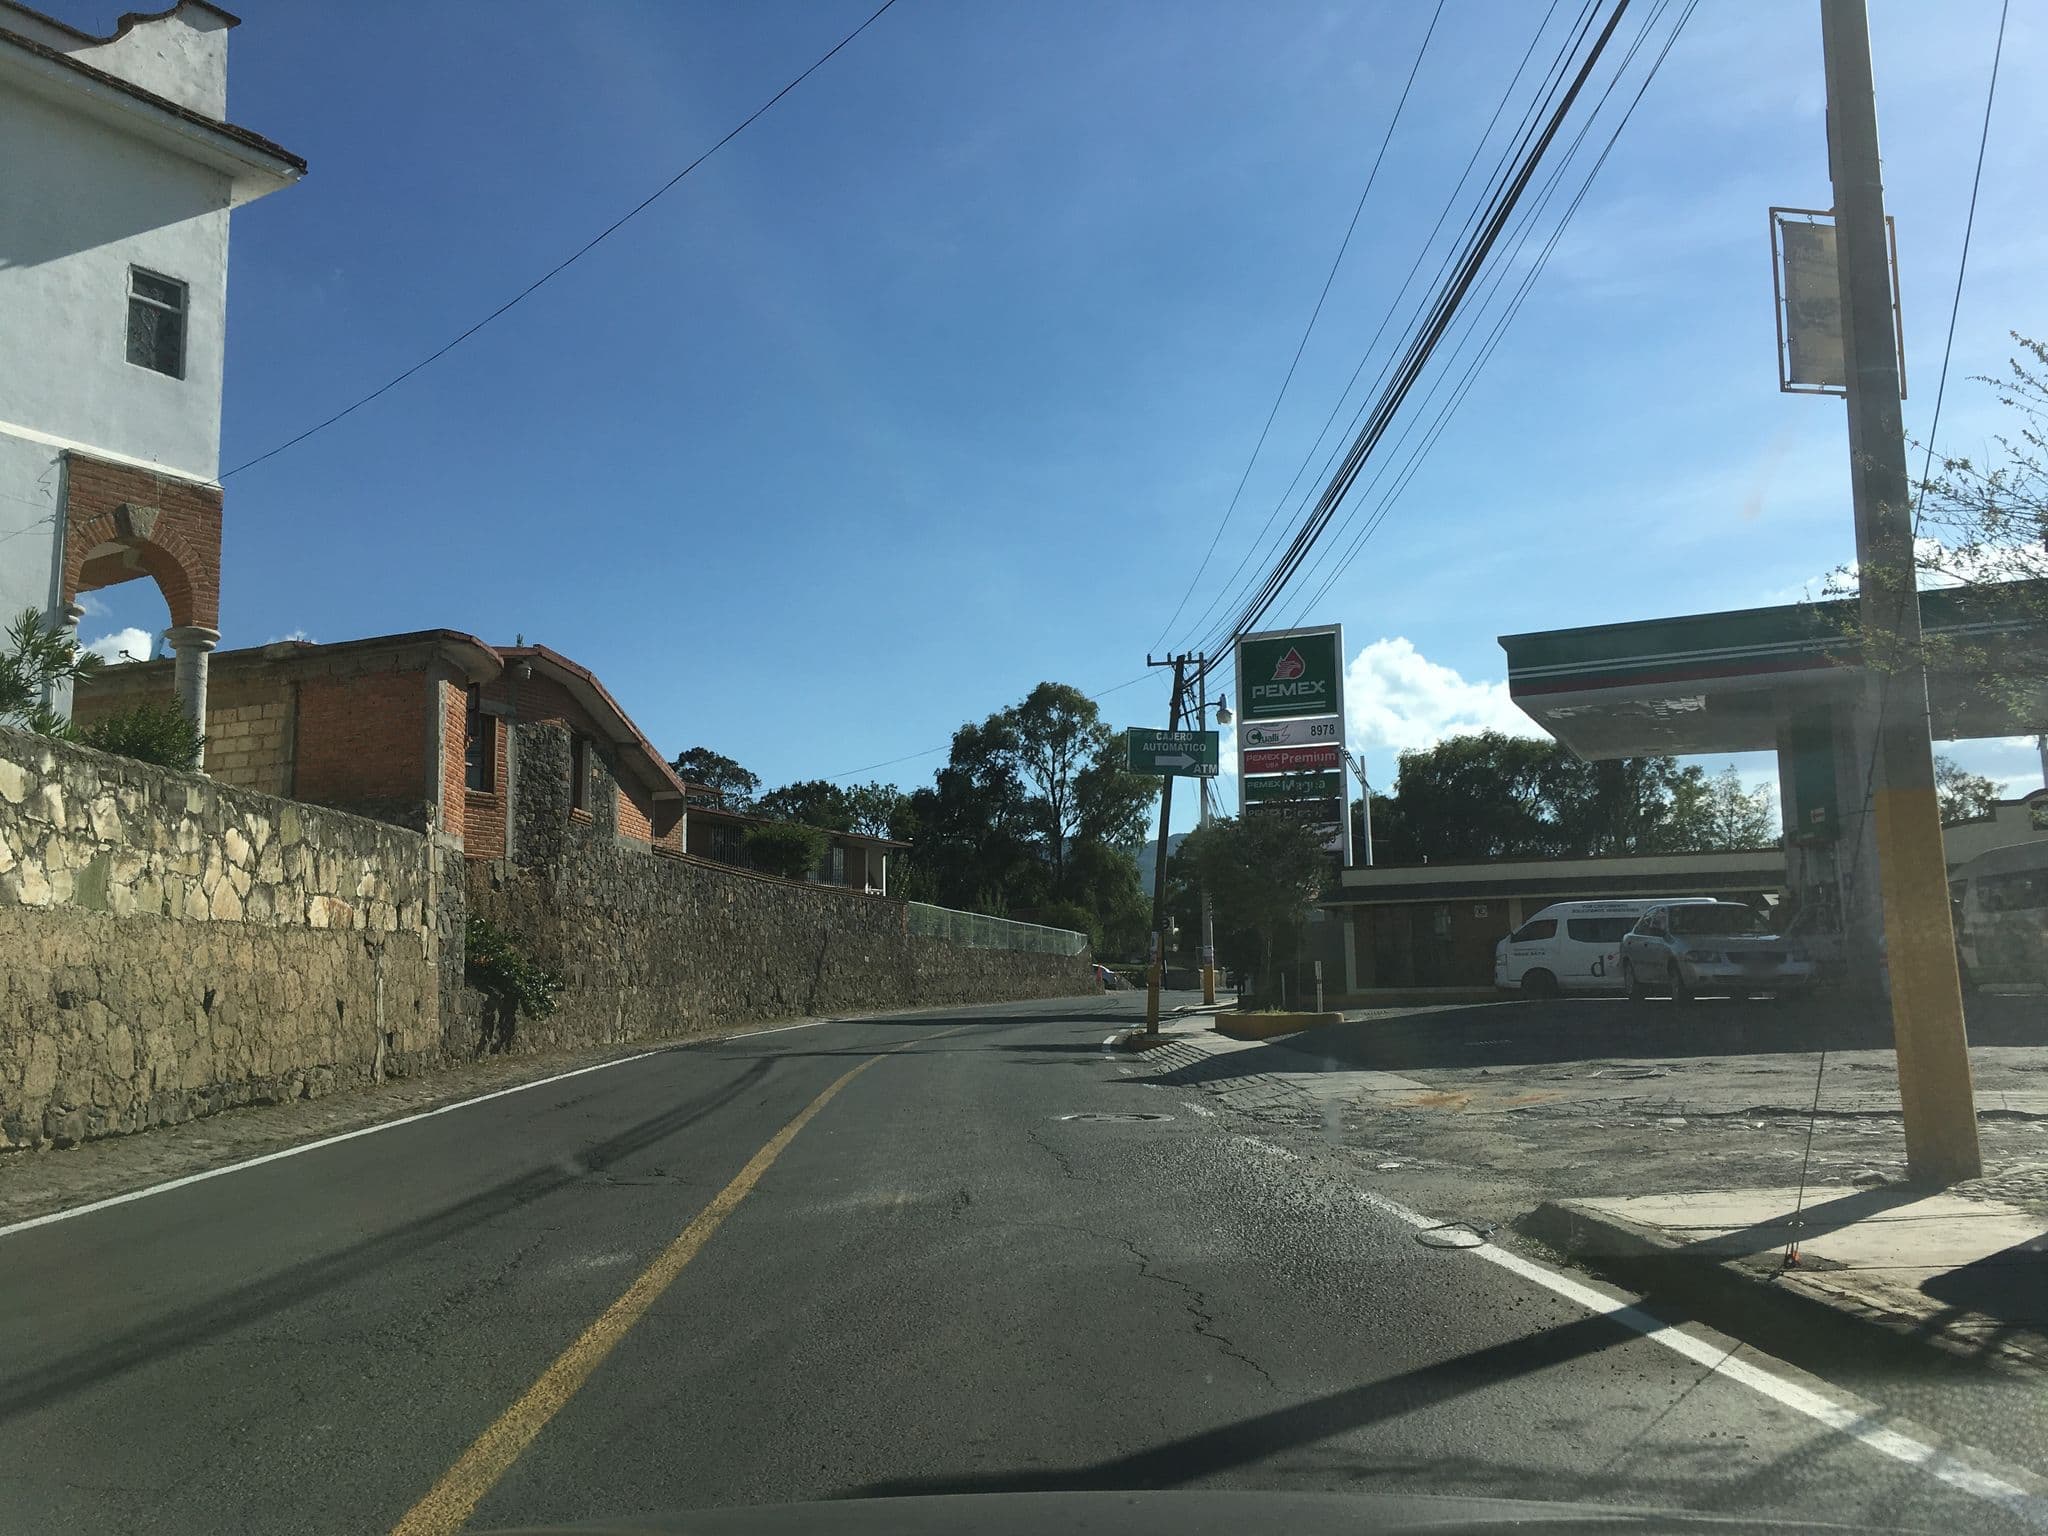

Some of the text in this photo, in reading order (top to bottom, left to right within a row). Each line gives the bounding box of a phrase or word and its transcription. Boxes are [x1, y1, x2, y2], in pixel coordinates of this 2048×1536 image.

[1251, 680, 1326, 699] PEMEX
[1310, 724, 1335, 736] 8978
[1156, 732, 1193, 741] CAJERO
[1142, 743, 1207, 752] AUTOMATICO
[1246, 752, 1336, 764] PEMEX Premium
[1193, 763, 1217, 774] ATM
[1247, 780, 1281, 789] PEMEX
